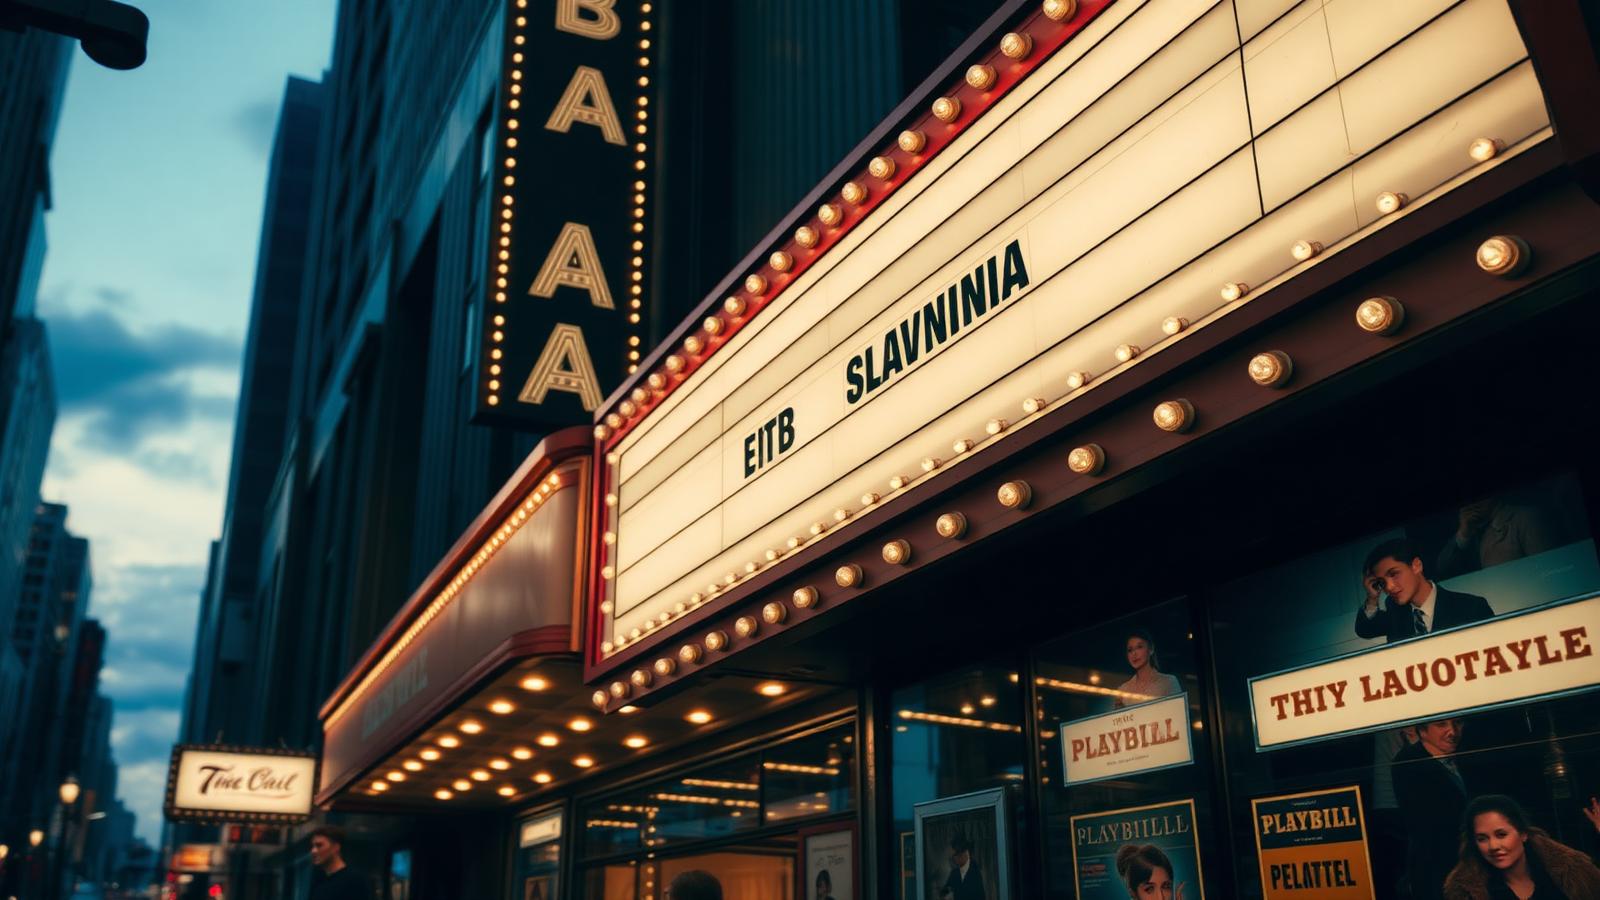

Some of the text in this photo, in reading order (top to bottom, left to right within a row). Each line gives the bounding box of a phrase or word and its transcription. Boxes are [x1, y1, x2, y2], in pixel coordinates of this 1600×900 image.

[744, 239, 1030, 479] EITB SLAVNINIA
[1271, 626, 1593, 721] THIY LAUOTAYLE
[1071, 718, 1180, 762] PLAYBILL
[1261, 806, 1357, 835] PLAYBILL
[1270, 859, 1357, 890] PELATTEL
